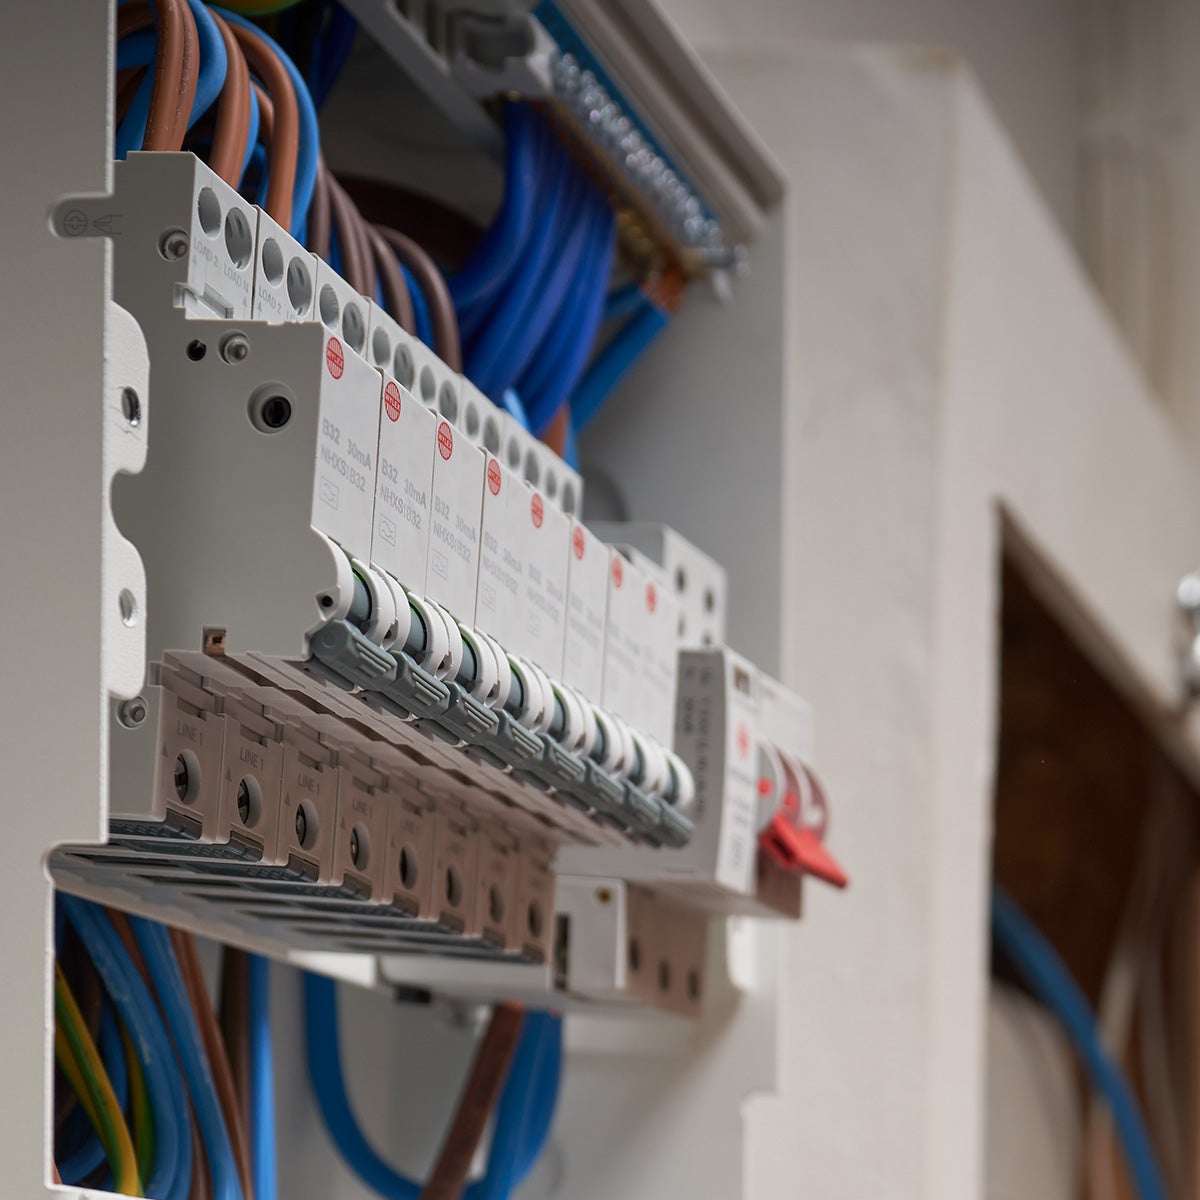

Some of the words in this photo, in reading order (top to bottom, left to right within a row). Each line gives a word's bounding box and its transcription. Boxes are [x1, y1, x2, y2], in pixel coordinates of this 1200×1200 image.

[194, 237, 213, 261] LOAD
[223, 262, 243, 288] LOAD
[258, 284, 277, 309] LOAD
[322, 417, 340, 445] B32
[346, 438, 372, 471] 30mA
[381, 457, 398, 485] B32
[403, 477, 427, 510] 30mA
[434, 495, 450, 521] B32
[176, 719, 197, 743] LINE
[239, 746, 258, 769] LINE
[297, 771, 316, 794] LINE
